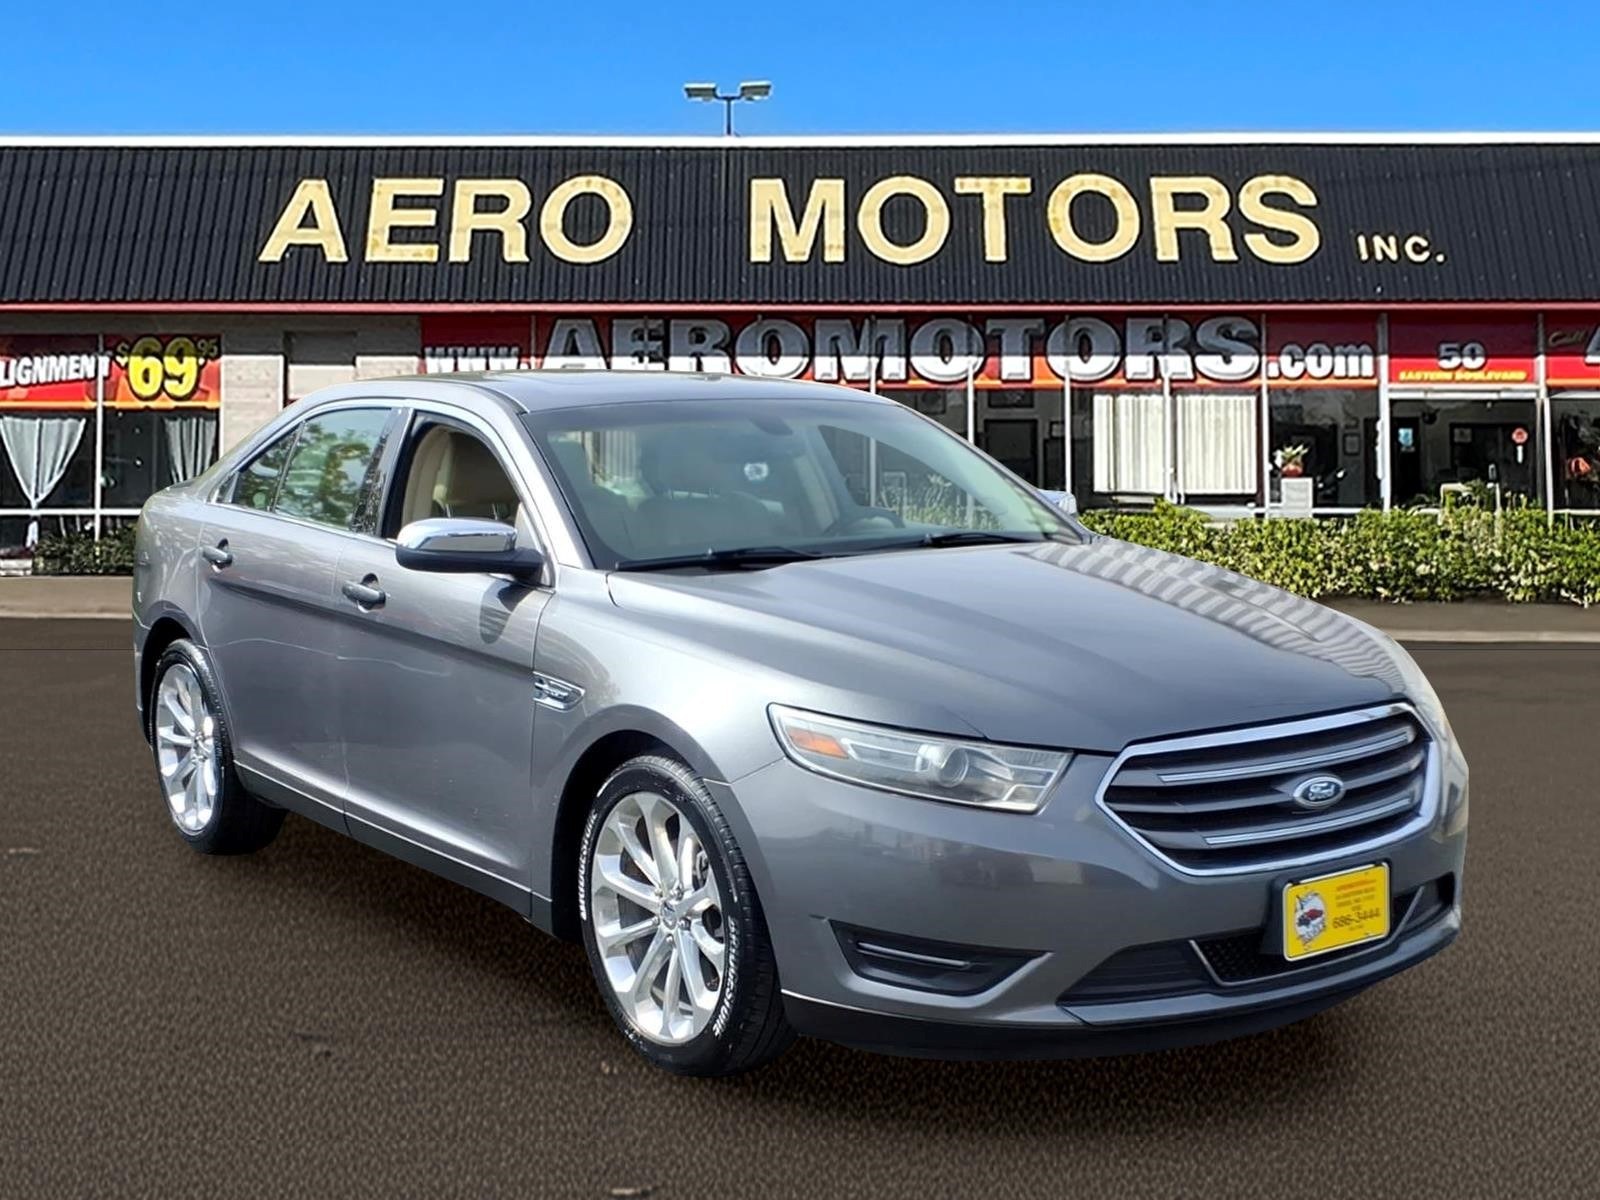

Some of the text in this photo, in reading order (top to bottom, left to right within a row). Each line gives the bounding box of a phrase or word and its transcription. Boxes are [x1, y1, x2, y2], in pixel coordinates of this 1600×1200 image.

[258, 174, 1446, 265] AERO MOTORS INC.
[1438, 342, 1486, 369] 50
